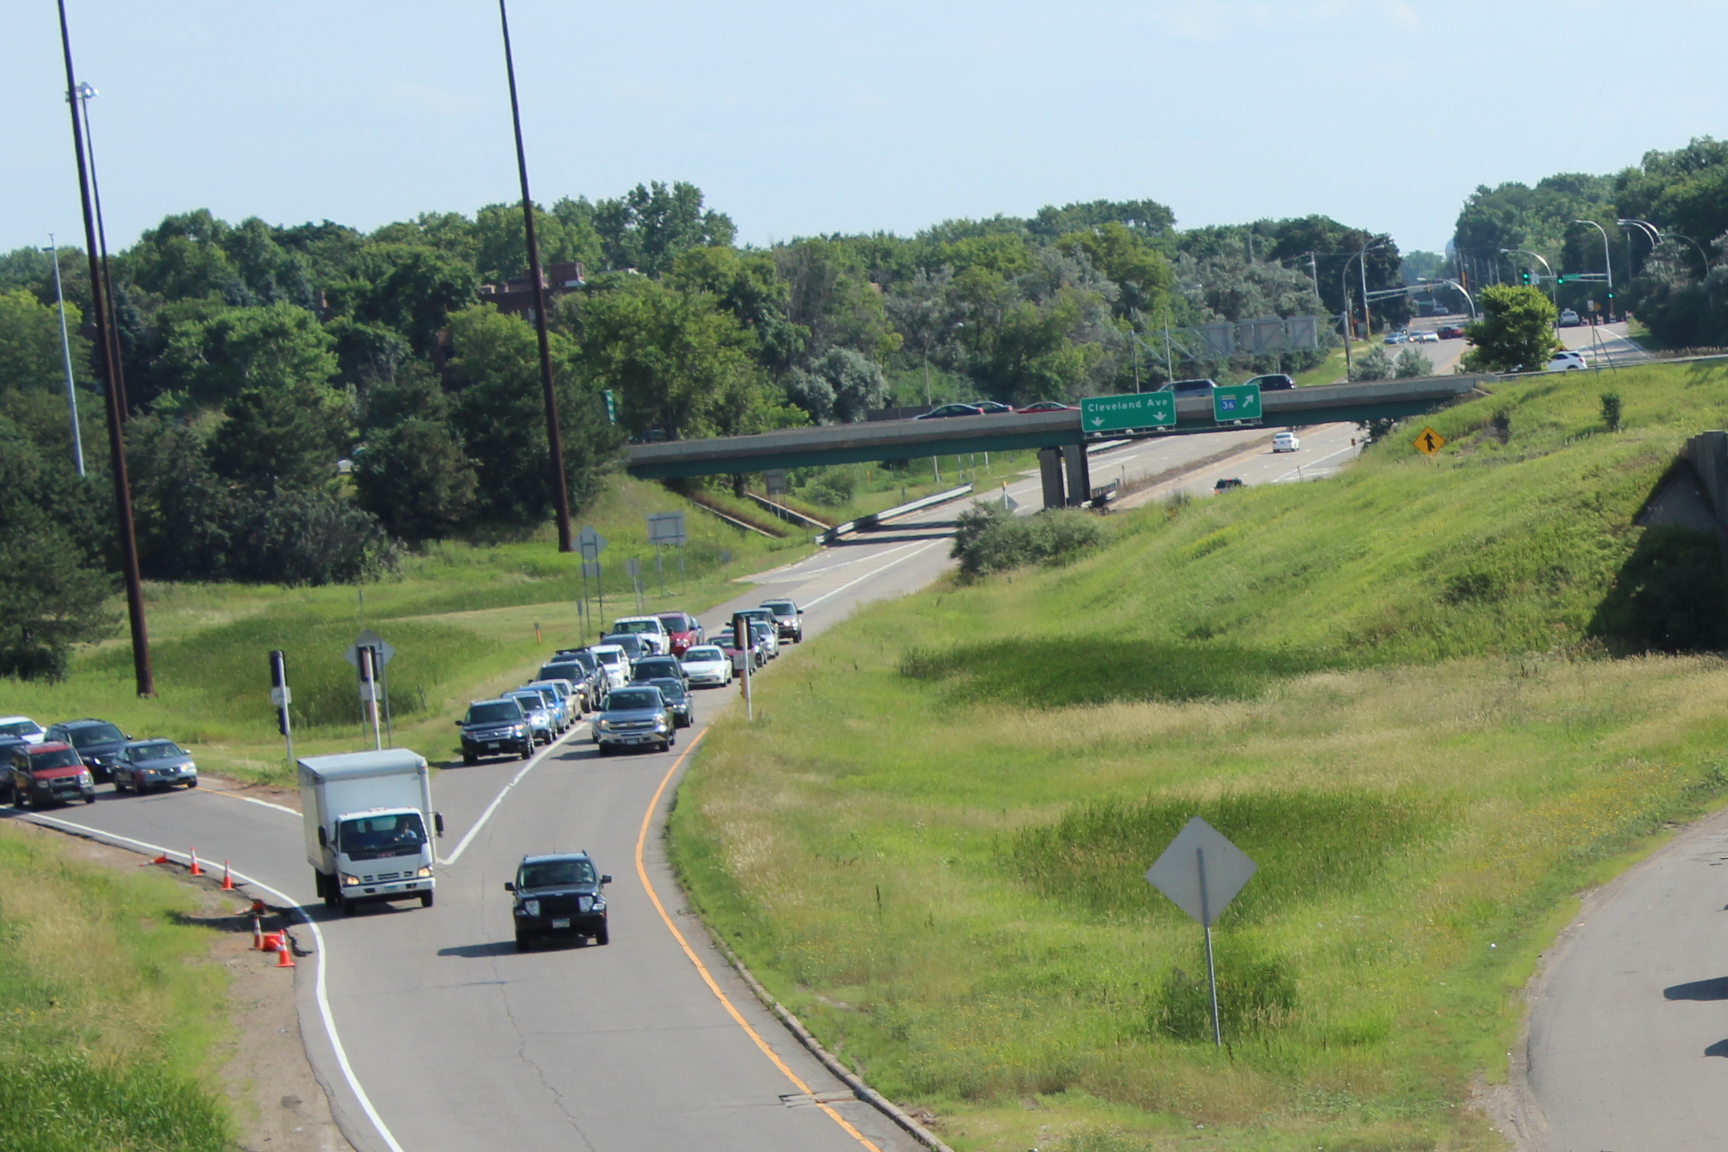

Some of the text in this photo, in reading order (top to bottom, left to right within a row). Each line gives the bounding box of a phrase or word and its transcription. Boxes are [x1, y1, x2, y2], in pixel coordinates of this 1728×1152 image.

[1088, 398, 1168, 412] Cleveland Ave
[1222, 401, 1235, 410] 36
